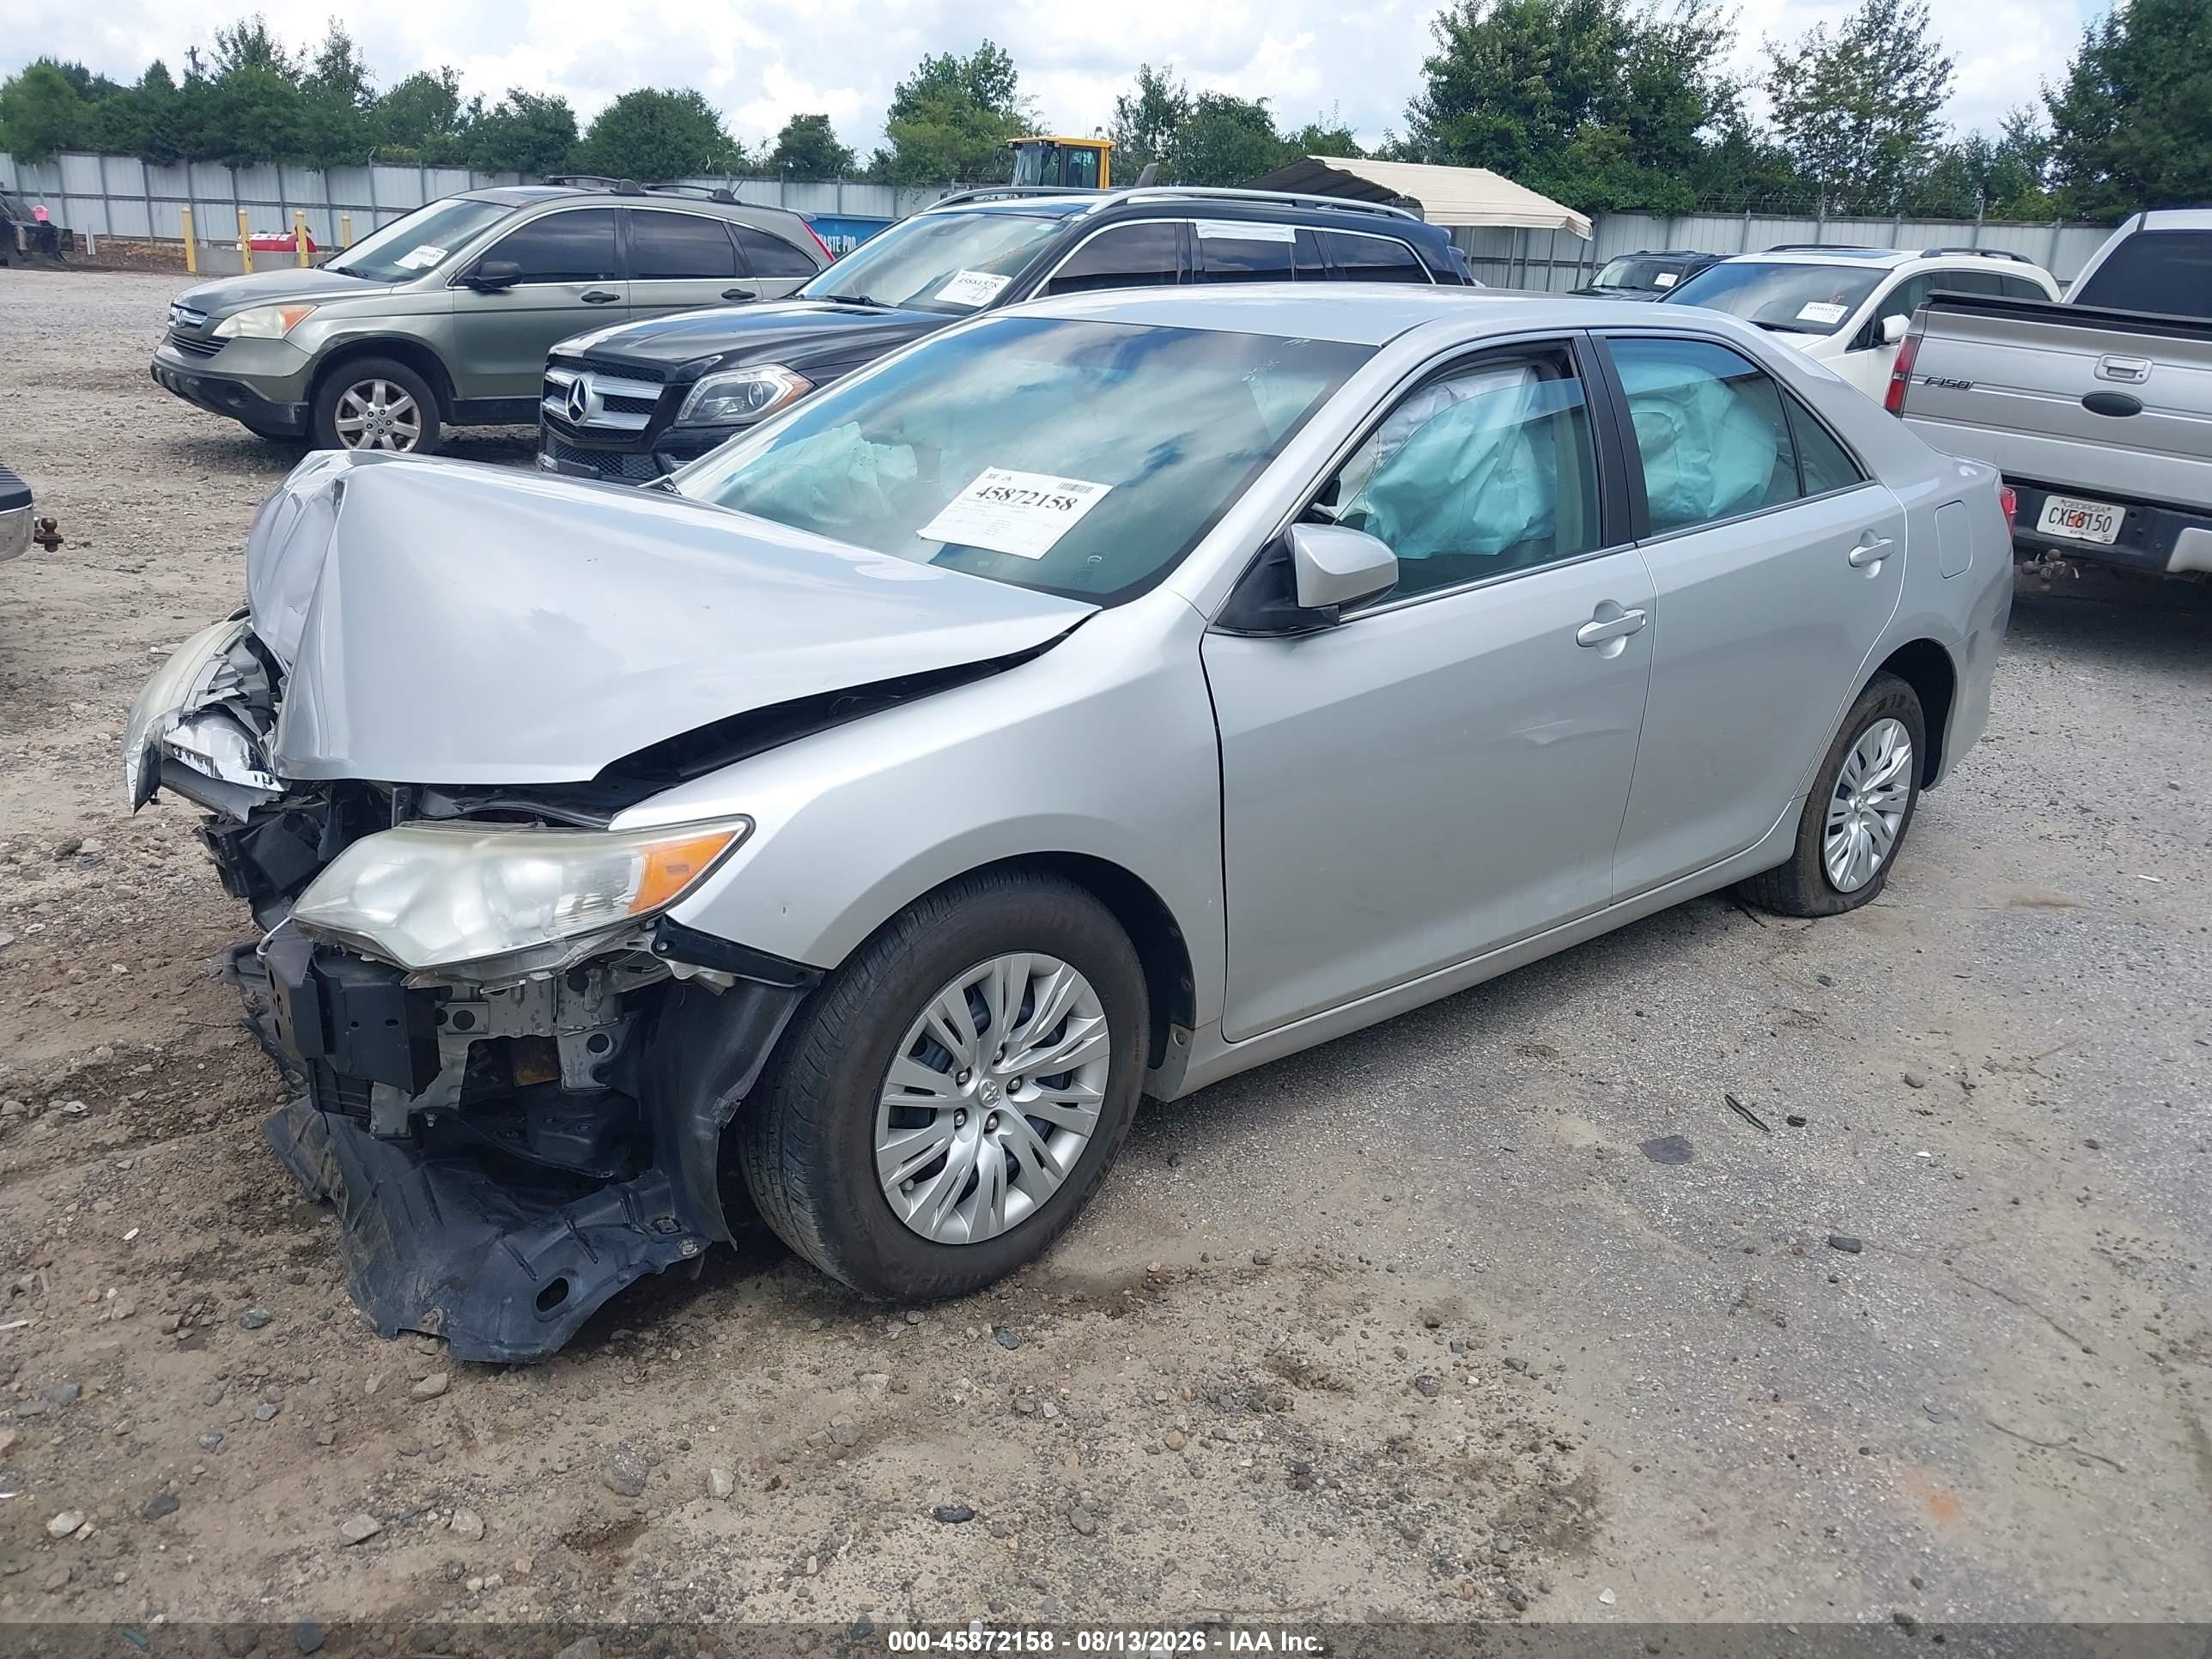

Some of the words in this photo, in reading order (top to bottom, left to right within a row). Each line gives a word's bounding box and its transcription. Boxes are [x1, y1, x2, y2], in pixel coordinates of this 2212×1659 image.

[975, 486, 1079, 511] 45872158
[2063, 501, 2106, 514] GEORGIA
[2048, 507, 2112, 533] CXE8150
